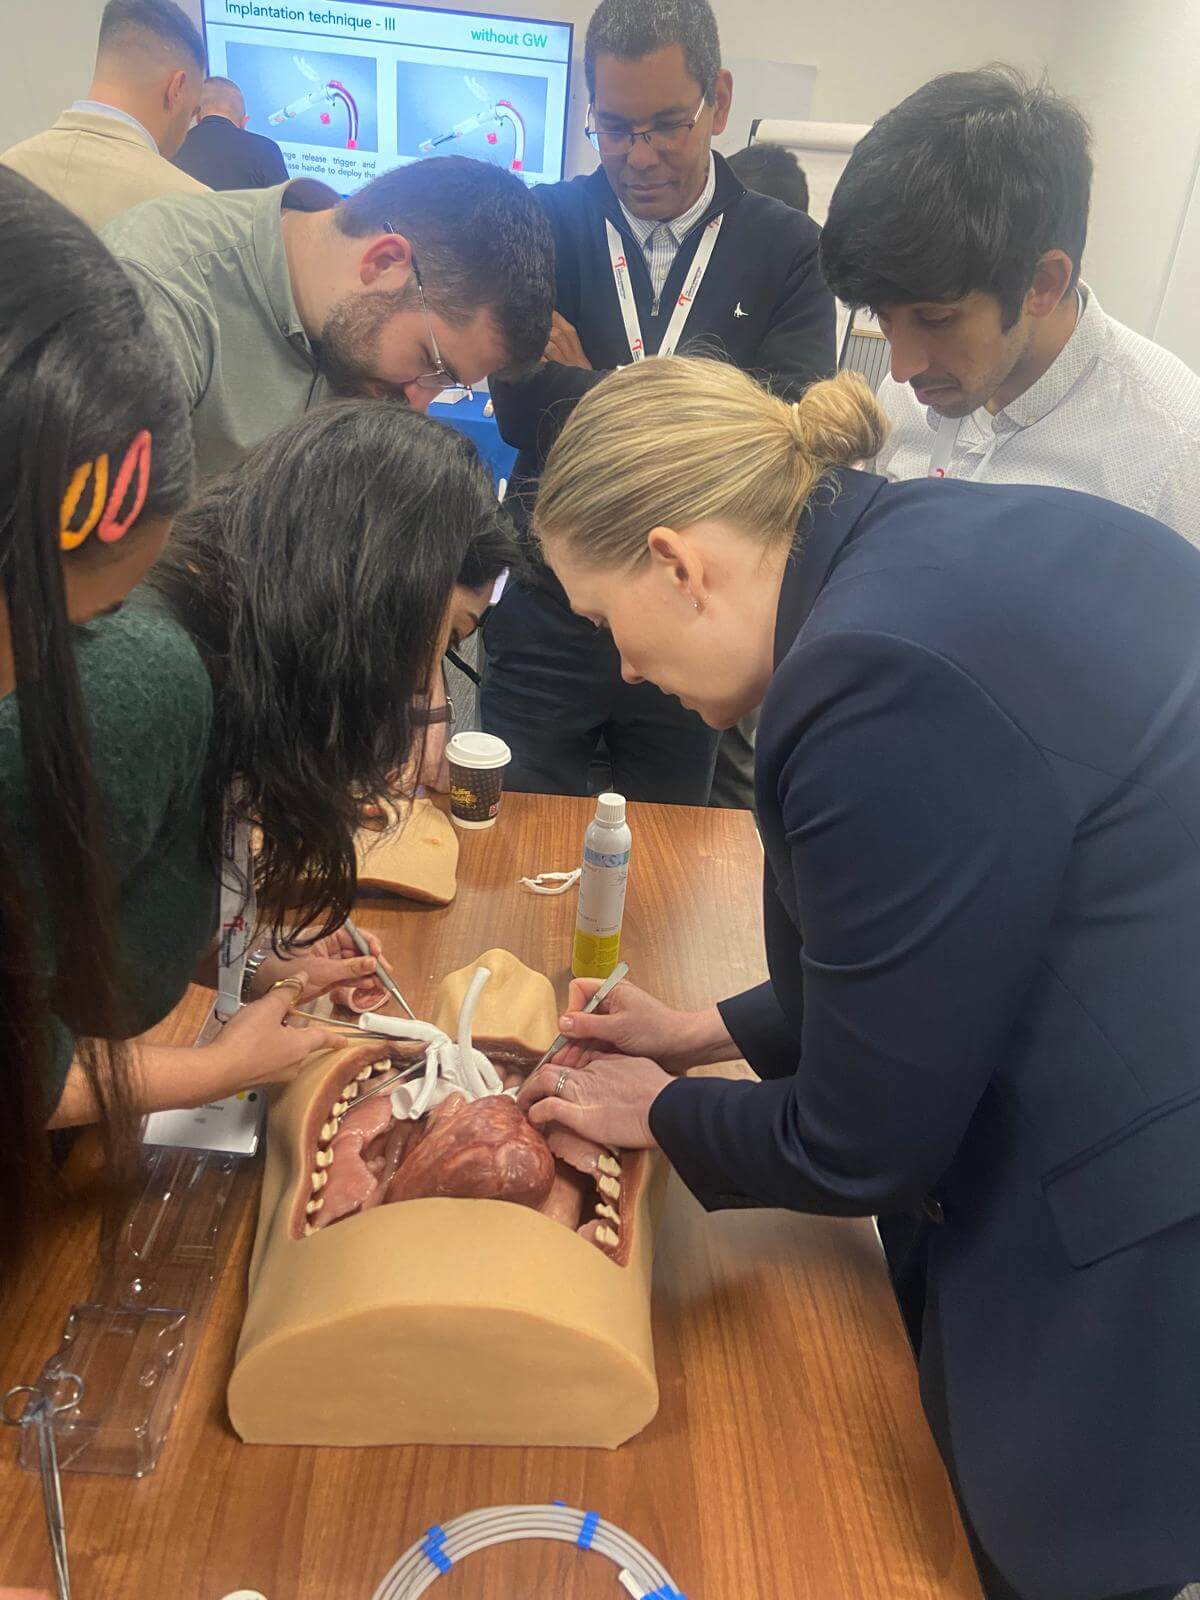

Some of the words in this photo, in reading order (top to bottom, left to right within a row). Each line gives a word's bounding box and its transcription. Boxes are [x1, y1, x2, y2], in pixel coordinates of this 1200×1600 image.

[225, 0, 305, 21] Implantation
[309, 9, 372, 31] technique
[384, 17, 396, 31] III
[471, 28, 519, 45] without
[522, 33, 548, 48] GW
[302, 153, 326, 163] release
[333, 157, 356, 168] trigger
[363, 161, 376, 169] and
[302, 163, 325, 173] handle
[328, 167, 336, 175] to
[337, 168, 362, 179] deploy
